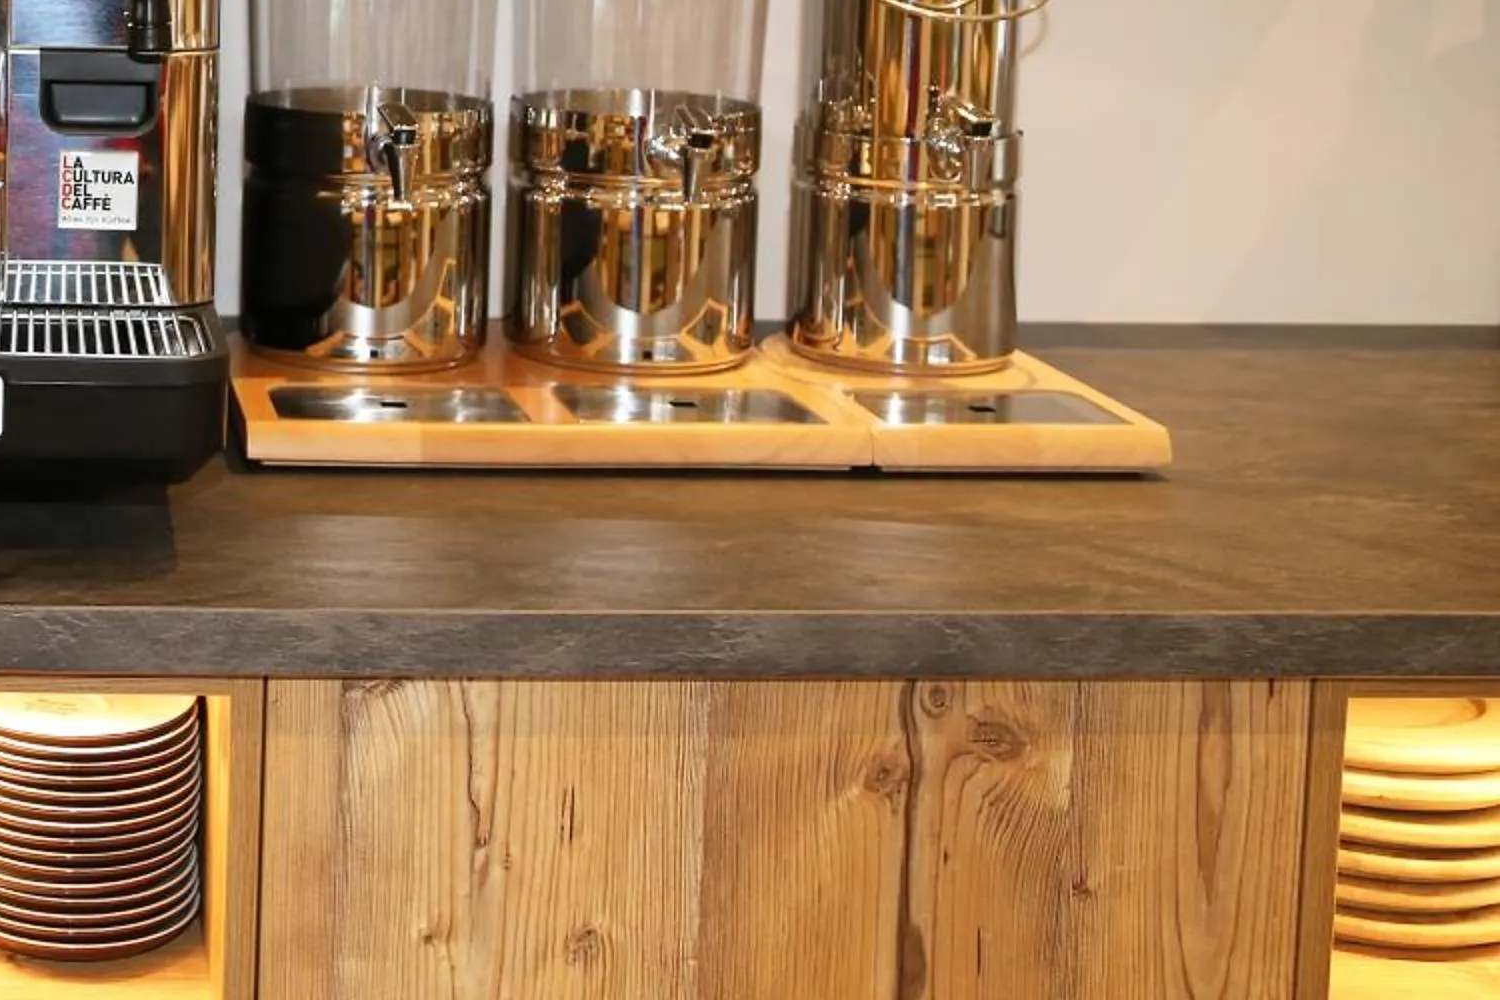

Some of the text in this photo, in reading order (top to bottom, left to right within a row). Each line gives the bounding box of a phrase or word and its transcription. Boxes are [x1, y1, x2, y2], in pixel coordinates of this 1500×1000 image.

[63, 156, 84, 168] LA
[62, 169, 135, 184] CULTURA
[62, 183, 92, 197] DEL
